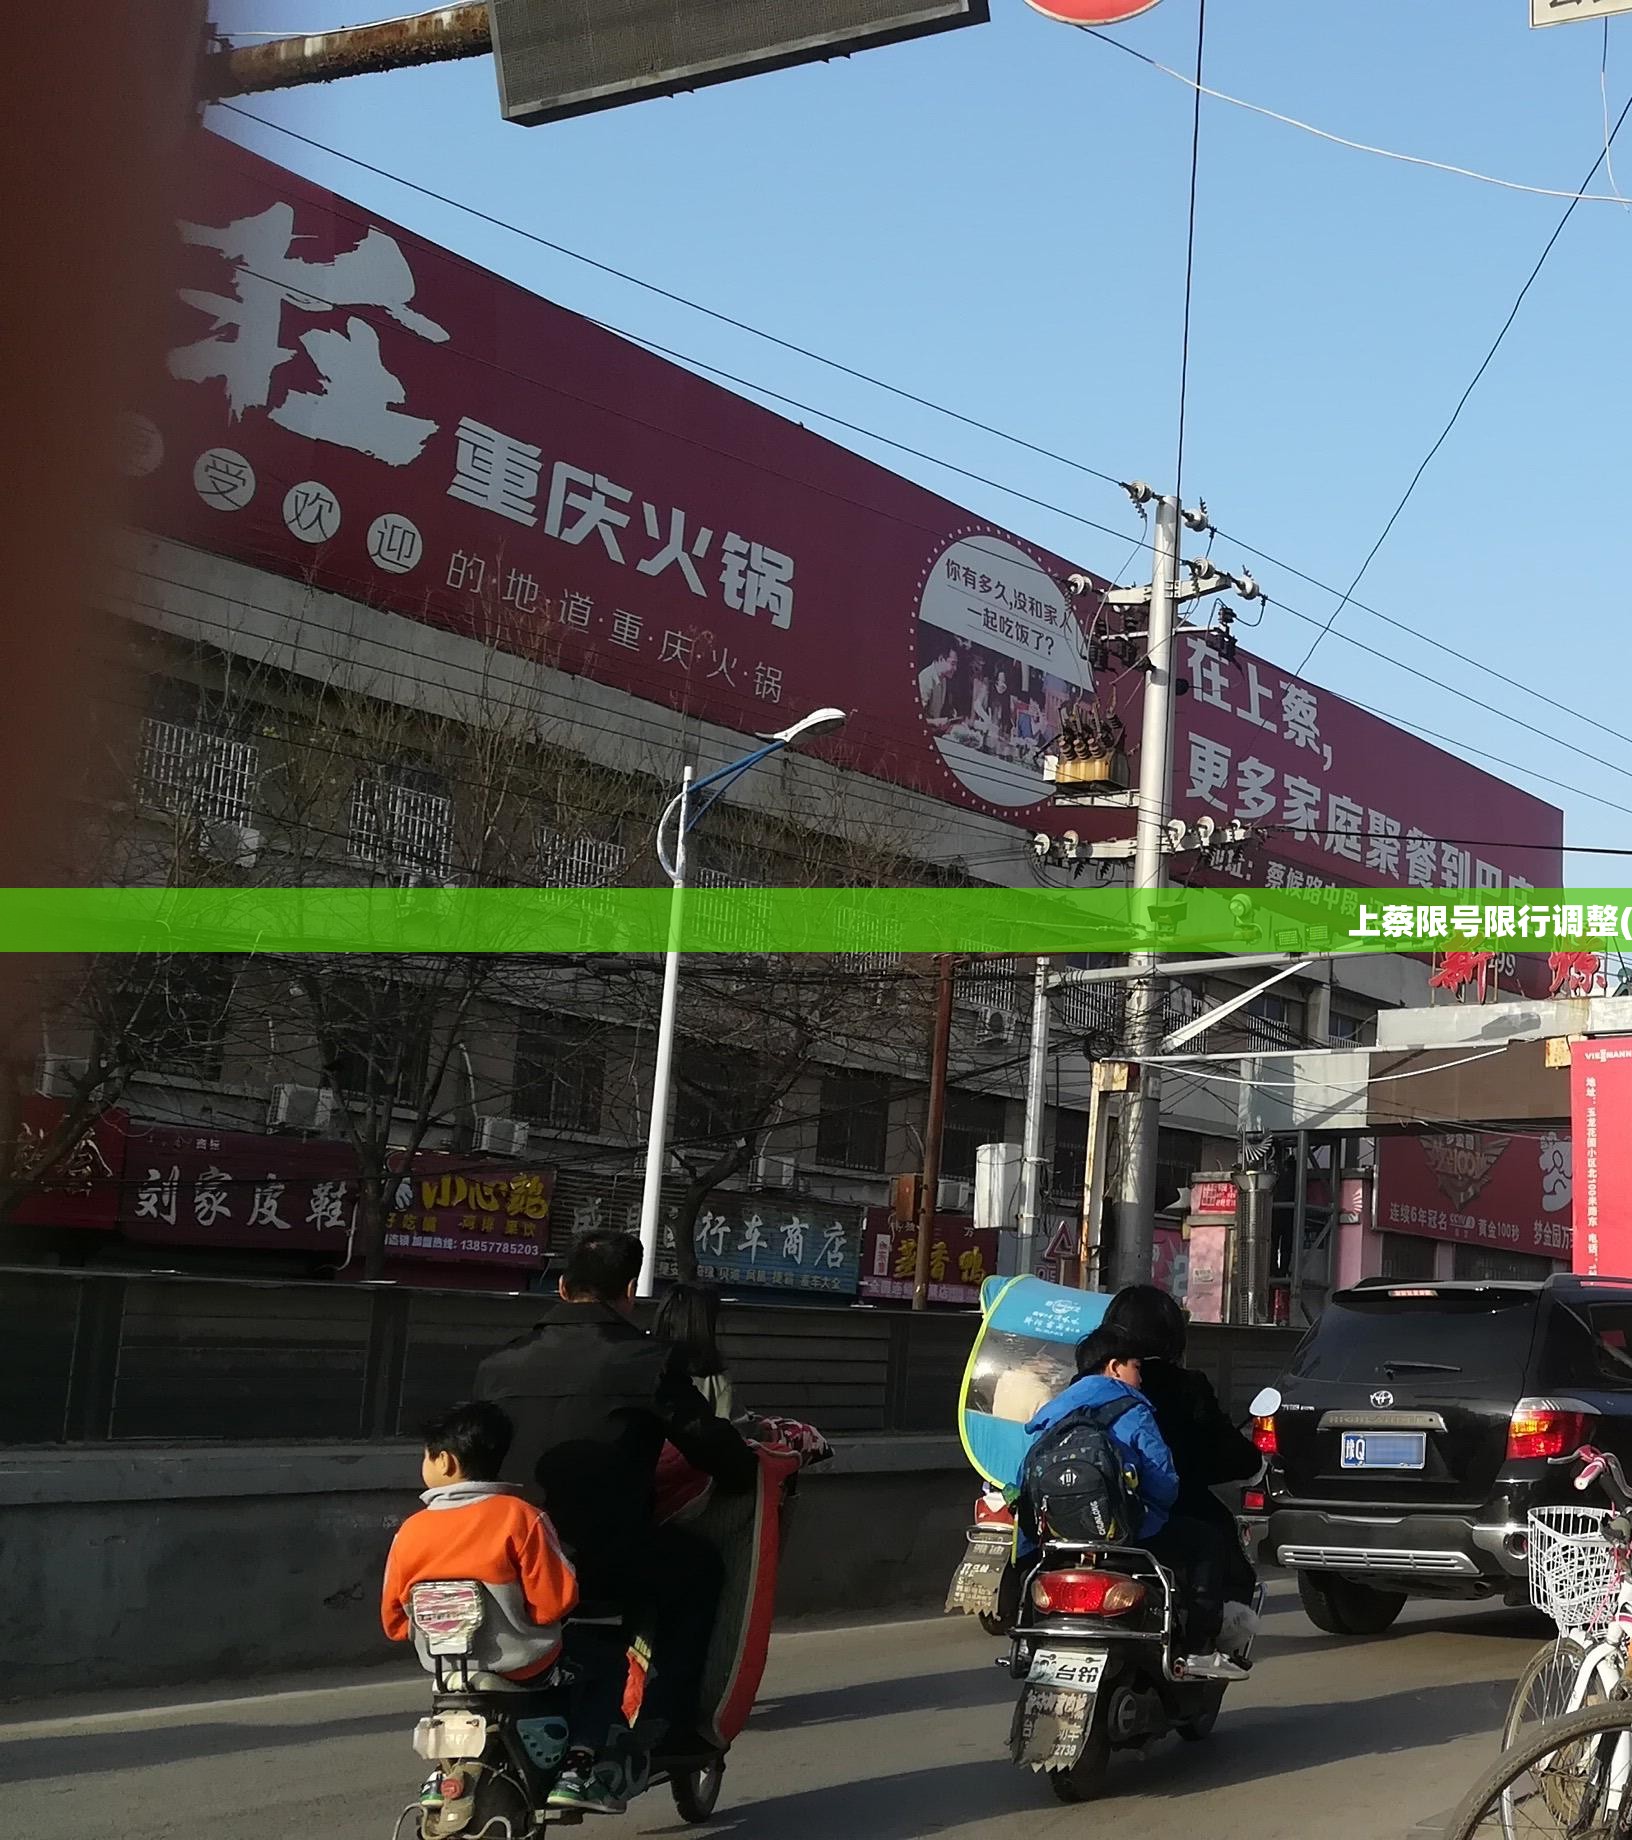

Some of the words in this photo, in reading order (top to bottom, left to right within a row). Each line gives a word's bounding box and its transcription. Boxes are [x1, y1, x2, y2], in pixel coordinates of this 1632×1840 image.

[446, 416, 798, 631] 重庆火锅
[135, 1165, 347, 1232] 刘家皮鞋
